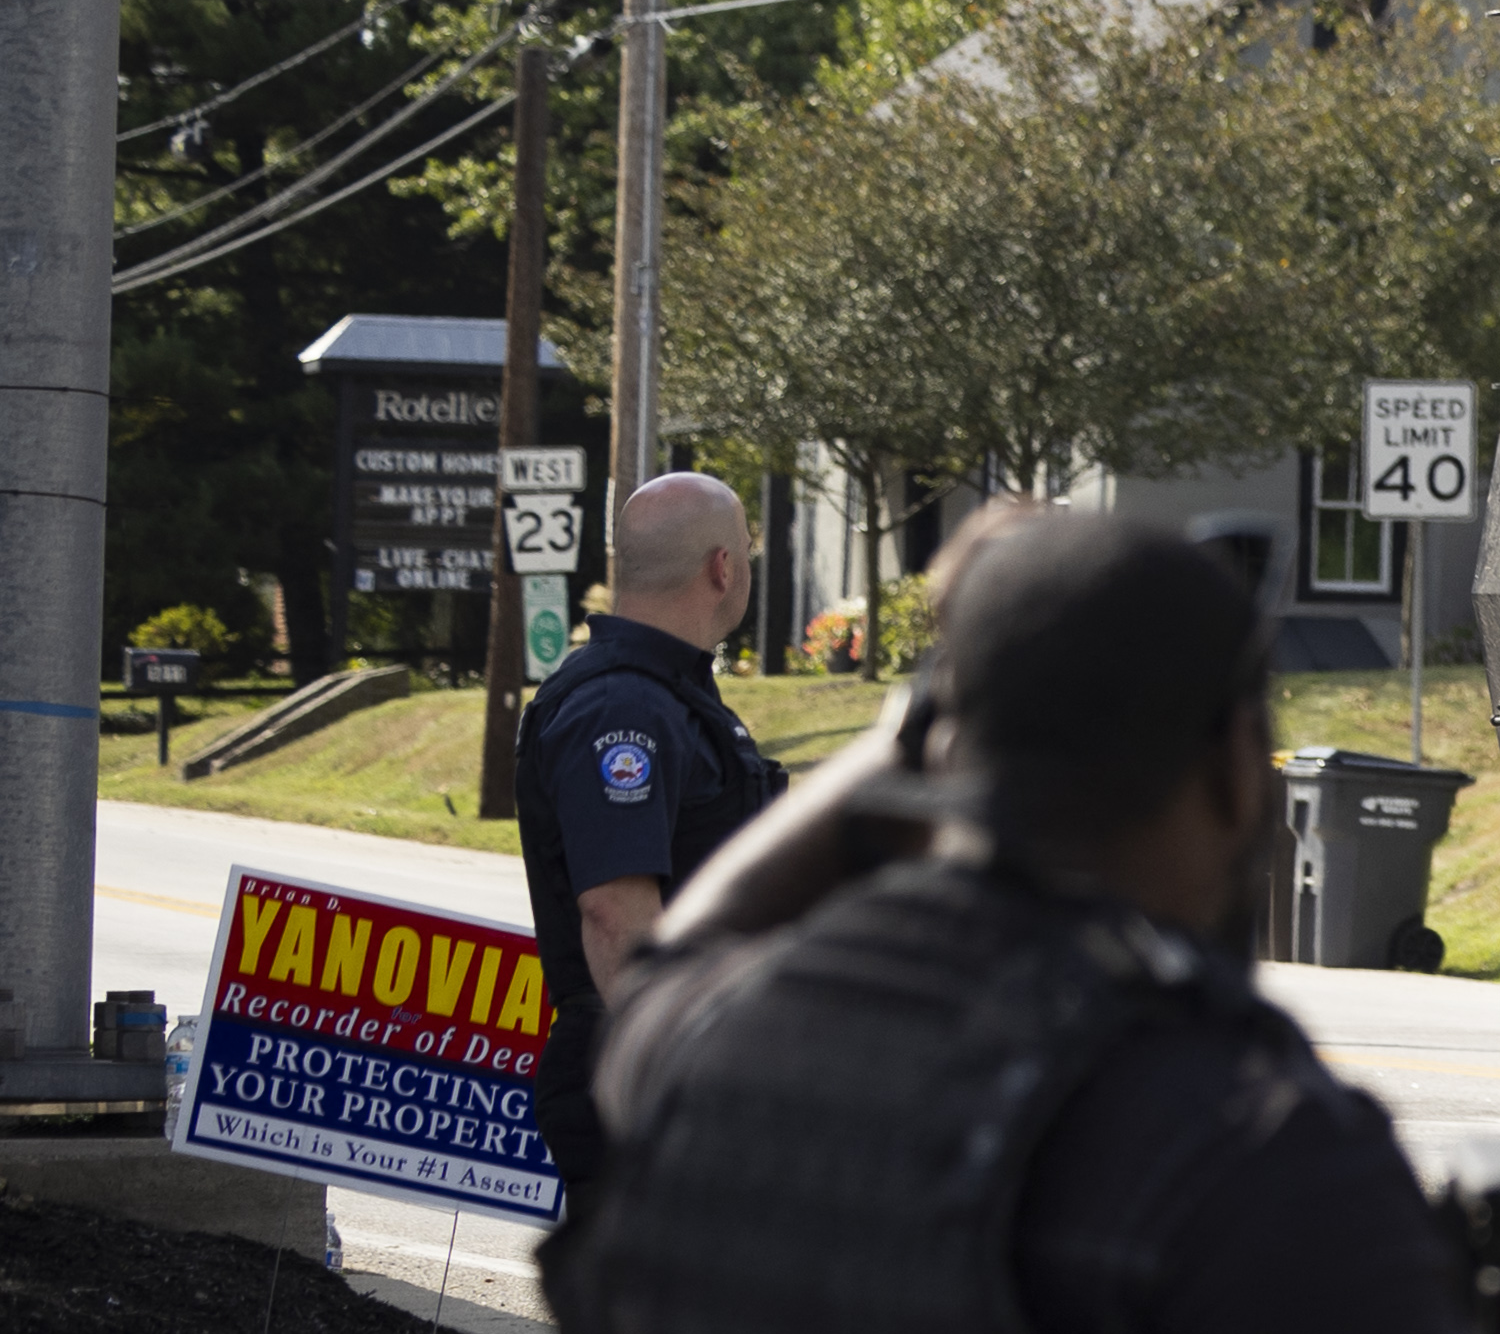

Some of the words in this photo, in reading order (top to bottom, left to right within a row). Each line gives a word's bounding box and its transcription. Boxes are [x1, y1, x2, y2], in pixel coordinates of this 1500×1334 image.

[1375, 397, 1466, 420] SPEED
[1383, 425, 1455, 447] LIMIT
[355, 450, 437, 473] CUSTOM
[510, 455, 575, 484] WEST
[1373, 454, 1466, 502] 40
[516, 509, 575, 553] 23
[593, 730, 657, 754] POLICE
[244, 880, 312, 905] Brian
[326, 897, 342, 913] D.
[238, 894, 558, 1038] YANOVIA
[220, 982, 402, 1046] Recorder
[414, 1025, 456, 1056] of
[462, 1033, 536, 1075] Dee
[390, 1005, 424, 1026] for
[210, 1062, 325, 1117] YOUR
[246, 1033, 530, 1120] PROTECTING
[215, 1113, 302, 1151] Which
[311, 1134, 334, 1157] is
[345, 1141, 408, 1174] Your
[416, 1155, 450, 1182] #1
[457, 1166, 543, 1202] Asset!
